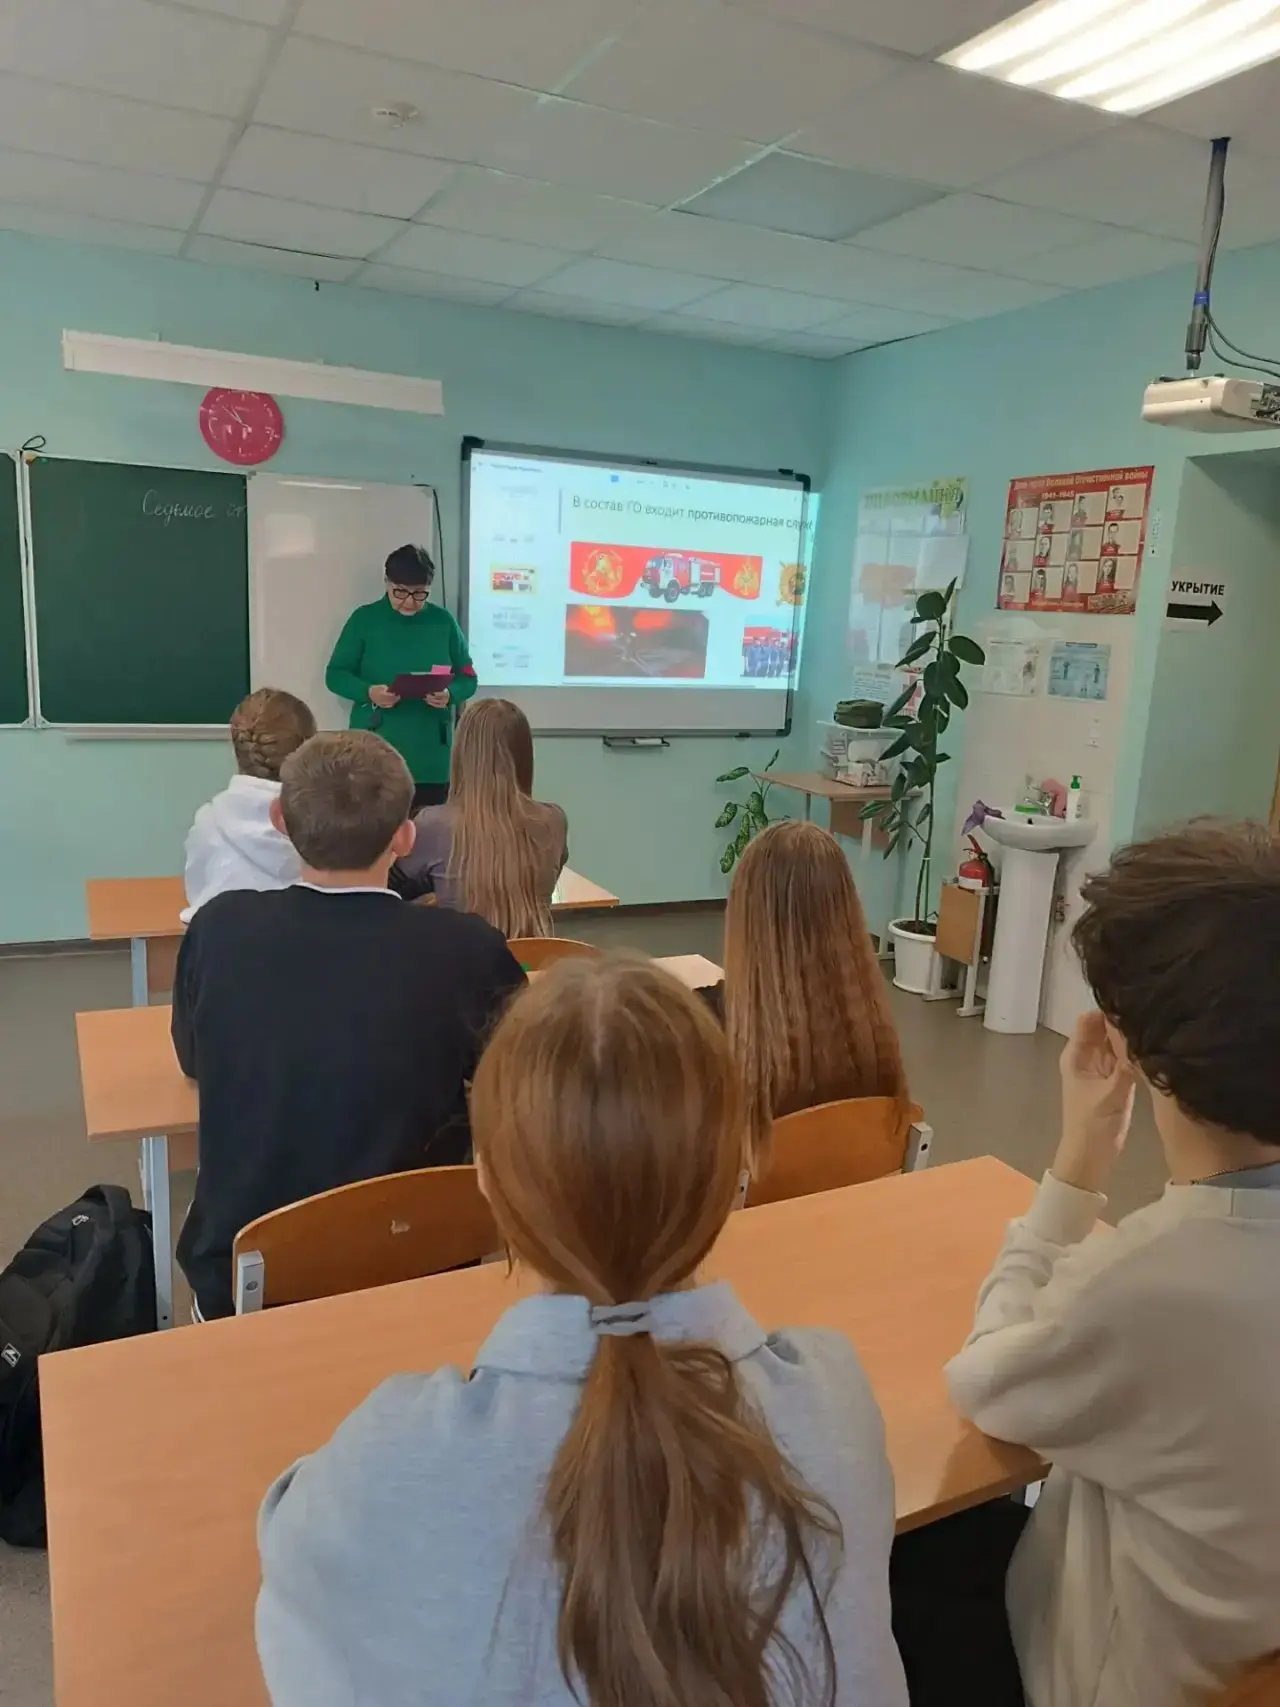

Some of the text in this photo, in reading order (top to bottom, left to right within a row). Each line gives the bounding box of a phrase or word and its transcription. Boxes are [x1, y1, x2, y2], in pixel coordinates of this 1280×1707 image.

[573, 495, 581, 508] В
[584, 500, 624, 512] состав
[627, 500, 642, 513] ГО
[645, 504, 685, 517] входит
[688, 509, 784, 527] противопожарная
[1171, 580, 1225, 596] УКРЫТИЕ
